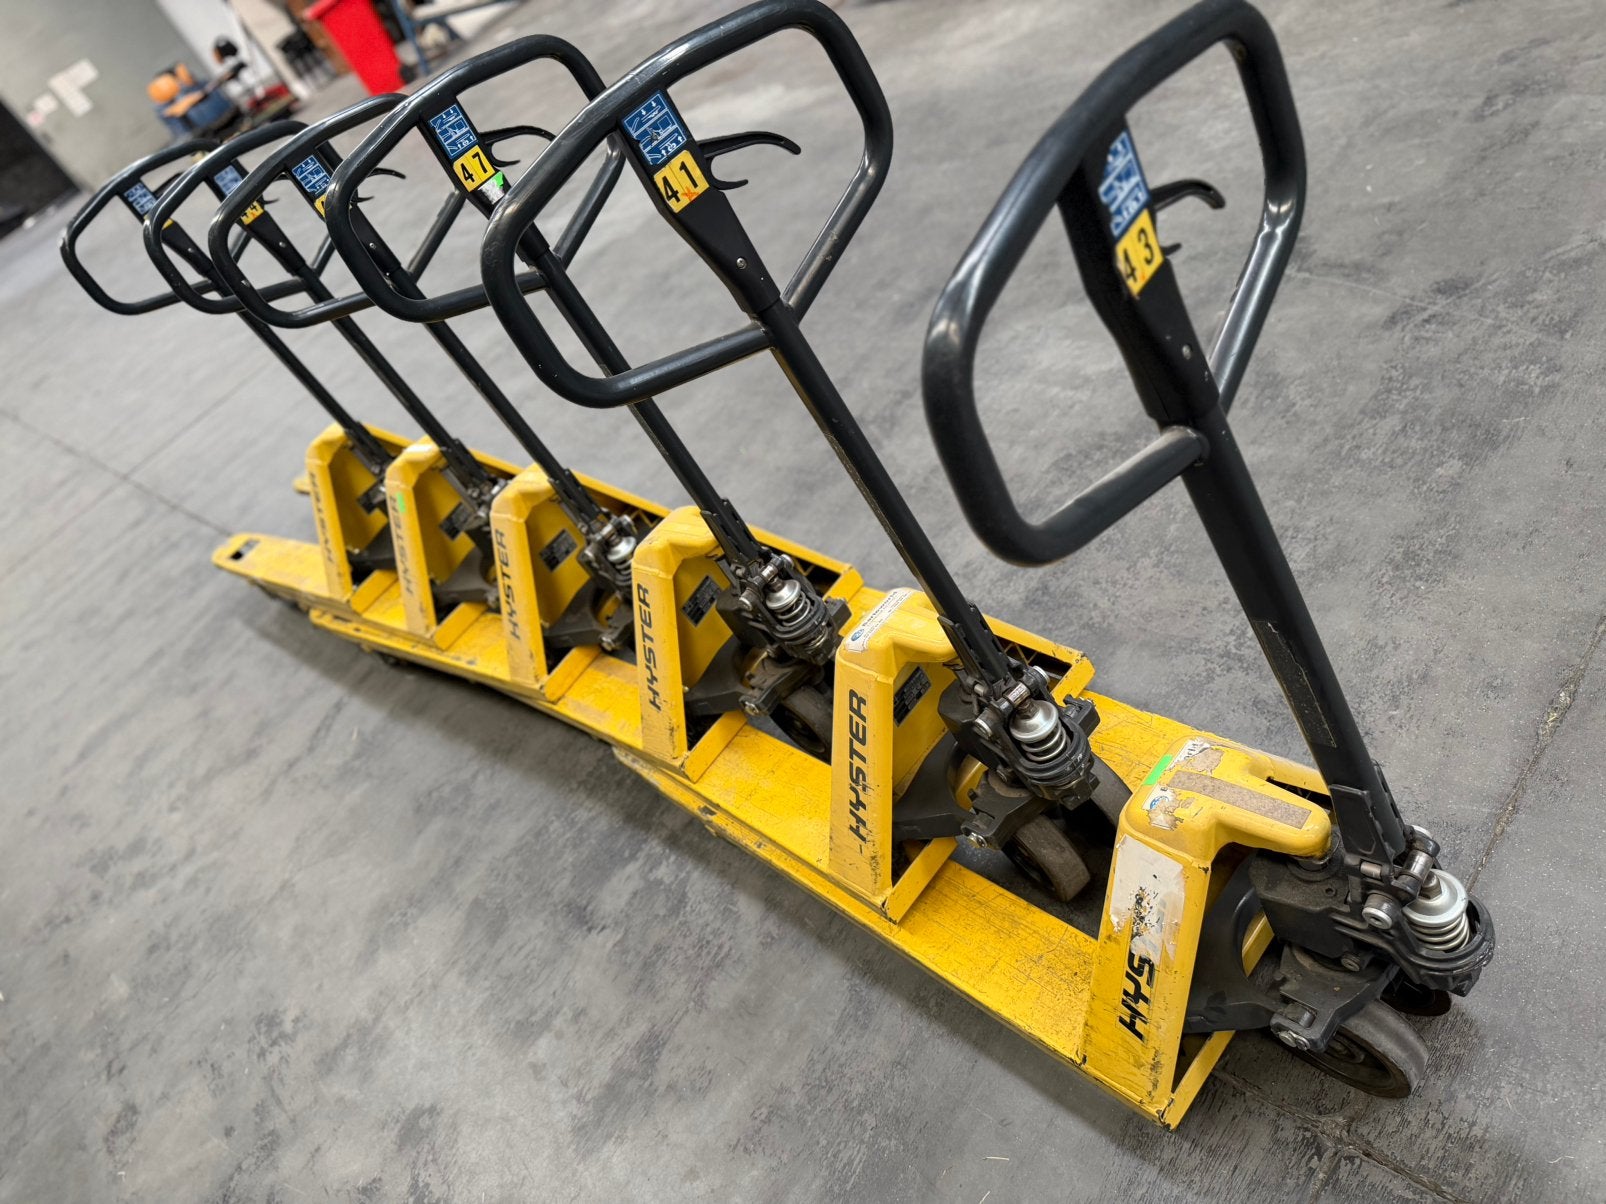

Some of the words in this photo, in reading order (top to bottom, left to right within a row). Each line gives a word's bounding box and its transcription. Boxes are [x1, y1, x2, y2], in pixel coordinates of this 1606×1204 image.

[460, 151, 488, 183] 47
[661, 160, 698, 204] 41
[1123, 227, 1155, 283] 43
[494, 528, 521, 641] HYSTER
[637, 583, 662, 712] HYSTER
[848, 688, 867, 844] HYSTER
